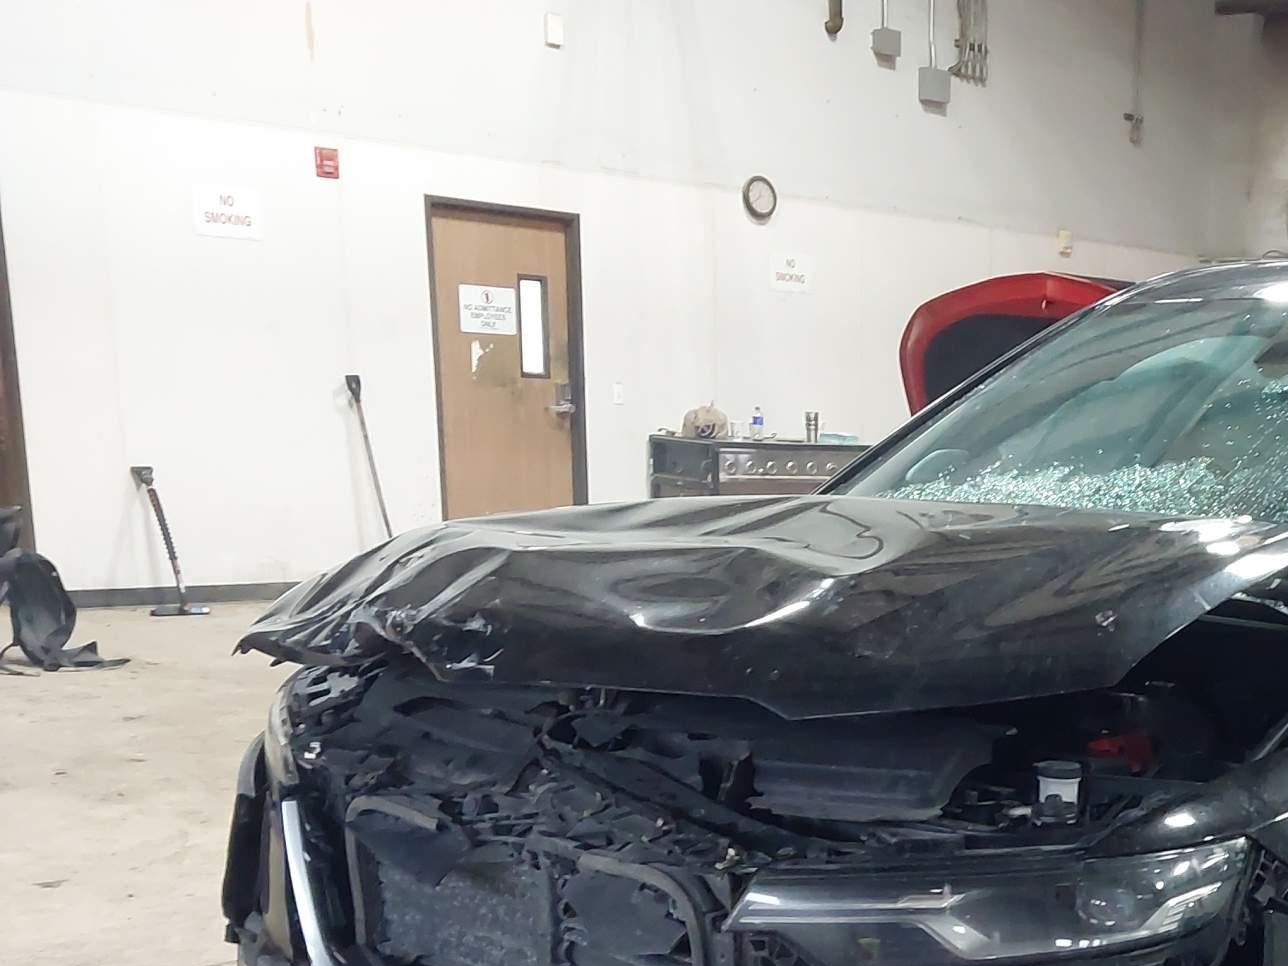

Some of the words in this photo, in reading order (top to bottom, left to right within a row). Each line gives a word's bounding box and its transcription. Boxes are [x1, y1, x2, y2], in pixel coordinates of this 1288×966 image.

[219, 194, 235, 207] NO
[204, 211, 252, 227] SMOKING
[775, 271, 806, 284] SMOKING
